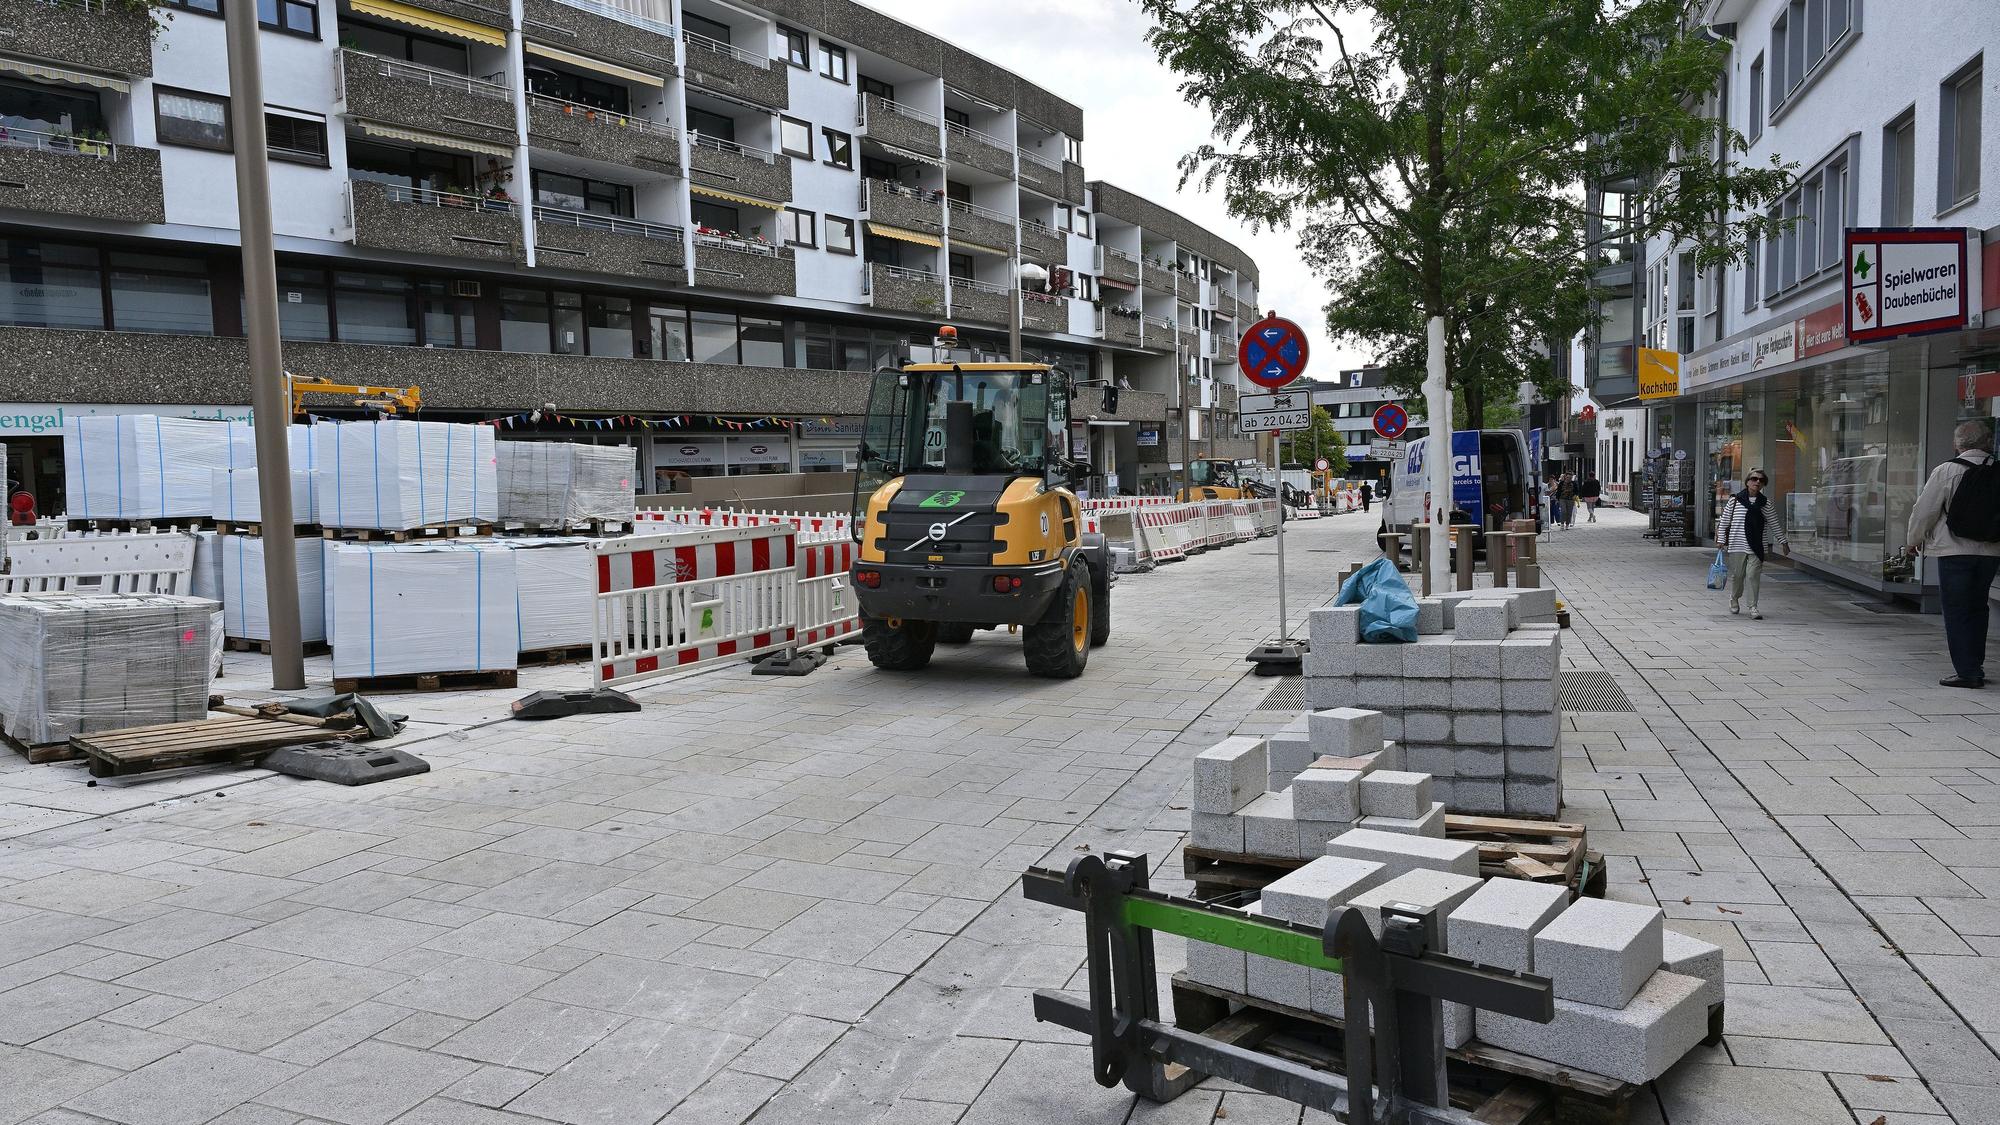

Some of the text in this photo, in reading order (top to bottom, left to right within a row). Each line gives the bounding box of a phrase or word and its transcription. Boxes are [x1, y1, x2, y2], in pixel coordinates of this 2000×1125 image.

[1884, 263, 1956, 291] Spielwaren
[1884, 283, 1956, 309] Daubenbüchel
[900, 339, 908, 347] 73
[1640, 381, 1678, 395] Kochshop
[0, 407, 64, 433] engal
[1244, 413, 1308, 428] ab 22.04.25
[927, 430, 942, 447] 20
[1407, 440, 1425, 475] GLS
